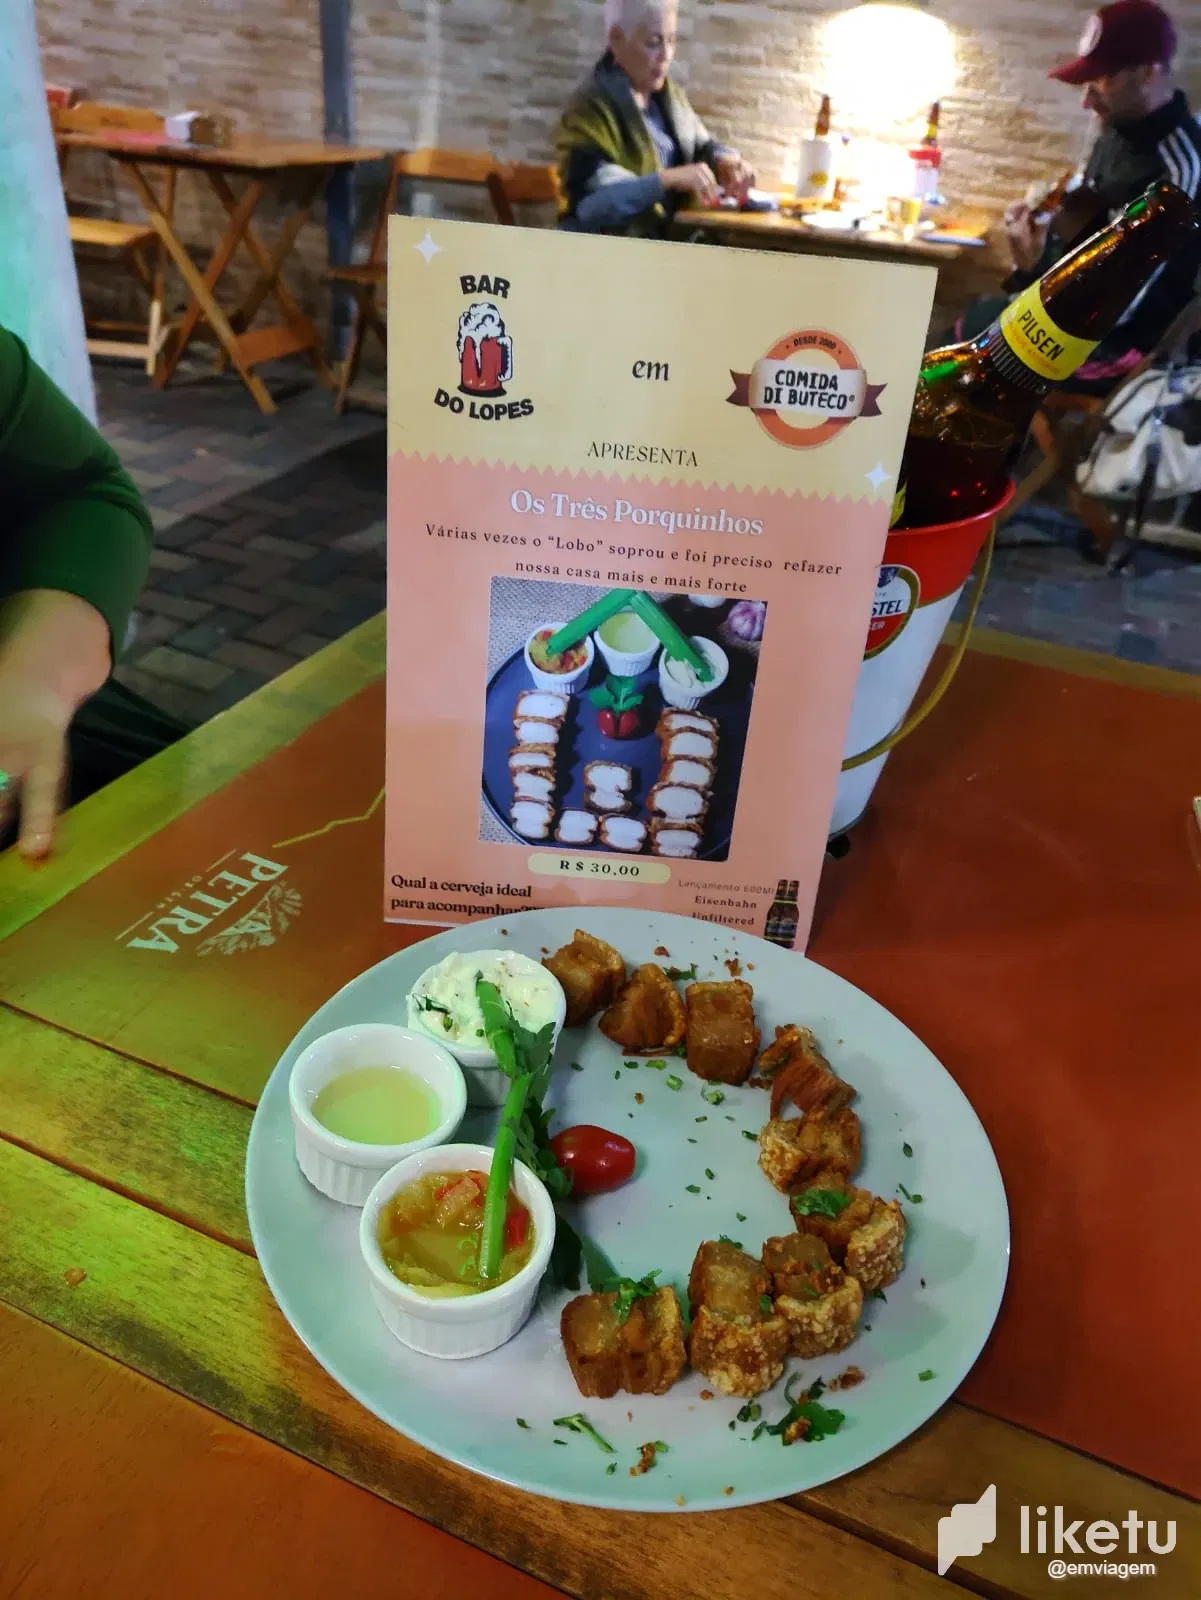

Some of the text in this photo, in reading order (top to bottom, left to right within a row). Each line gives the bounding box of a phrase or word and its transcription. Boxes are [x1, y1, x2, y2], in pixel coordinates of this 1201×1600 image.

[459, 274, 511, 299] BAR
[793, 335, 817, 347] DESDE
[1017, 309, 1065, 361] PILSEN
[631, 359, 669, 381] em
[774, 369, 839, 391] COMIDA
[433, 388, 535, 421] DO LOPES
[763, 386, 782, 405] DI
[587, 441, 698, 467] APRESENTA
[510, 489, 764, 535] Os Três Porquinhos
[425, 523, 477, 541] Várias
[484, 533, 527, 546] vezes
[533, 538, 542, 547] o
[609, 543, 664, 560] soprou
[671, 551, 679, 560] e
[685, 549, 707, 563] foi
[713, 553, 773, 570] preciso
[783, 559, 843, 575] refazer
[515, 561, 748, 593] nossa casa mais e mais forte
[391, 875, 532, 898] Qual a cerveja ideal
[126, 852, 289, 953] PETRA
[391, 898, 425, 911] para
[695, 895, 757, 909] Eisenbahn
